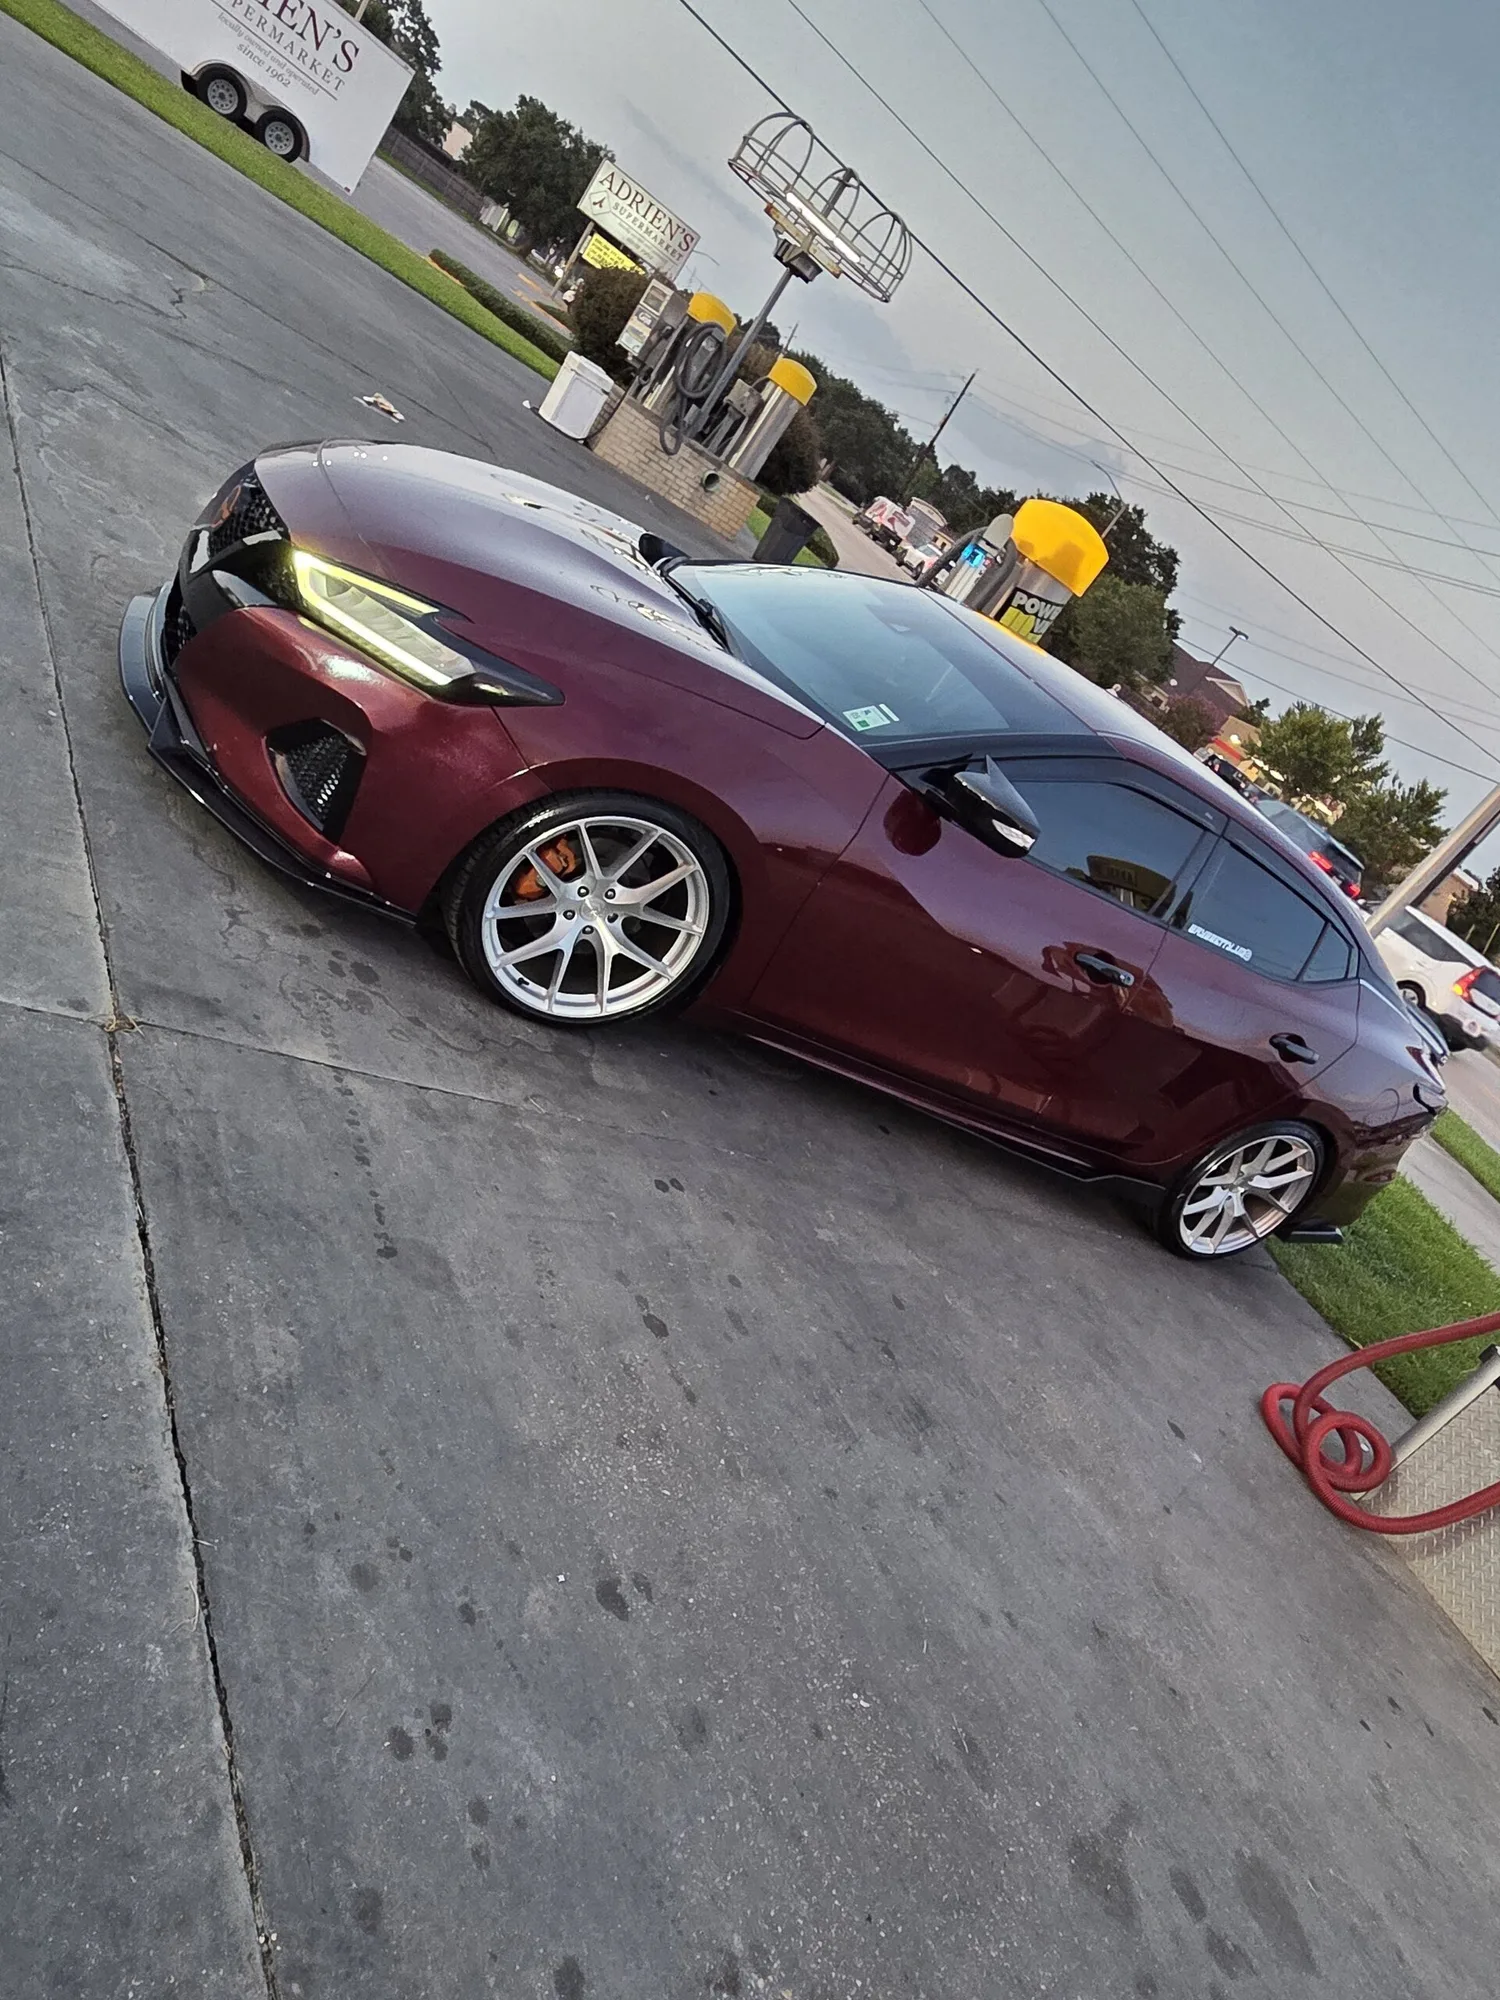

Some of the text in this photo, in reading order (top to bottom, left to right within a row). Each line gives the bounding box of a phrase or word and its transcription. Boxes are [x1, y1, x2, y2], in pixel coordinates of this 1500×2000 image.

[218, 12, 320, 95] locally owned and operated
[237, 44, 291, 88] since 1962
[599, 171, 695, 252] ADRIEN'S
[612, 201, 684, 261] SUPERMARKET
